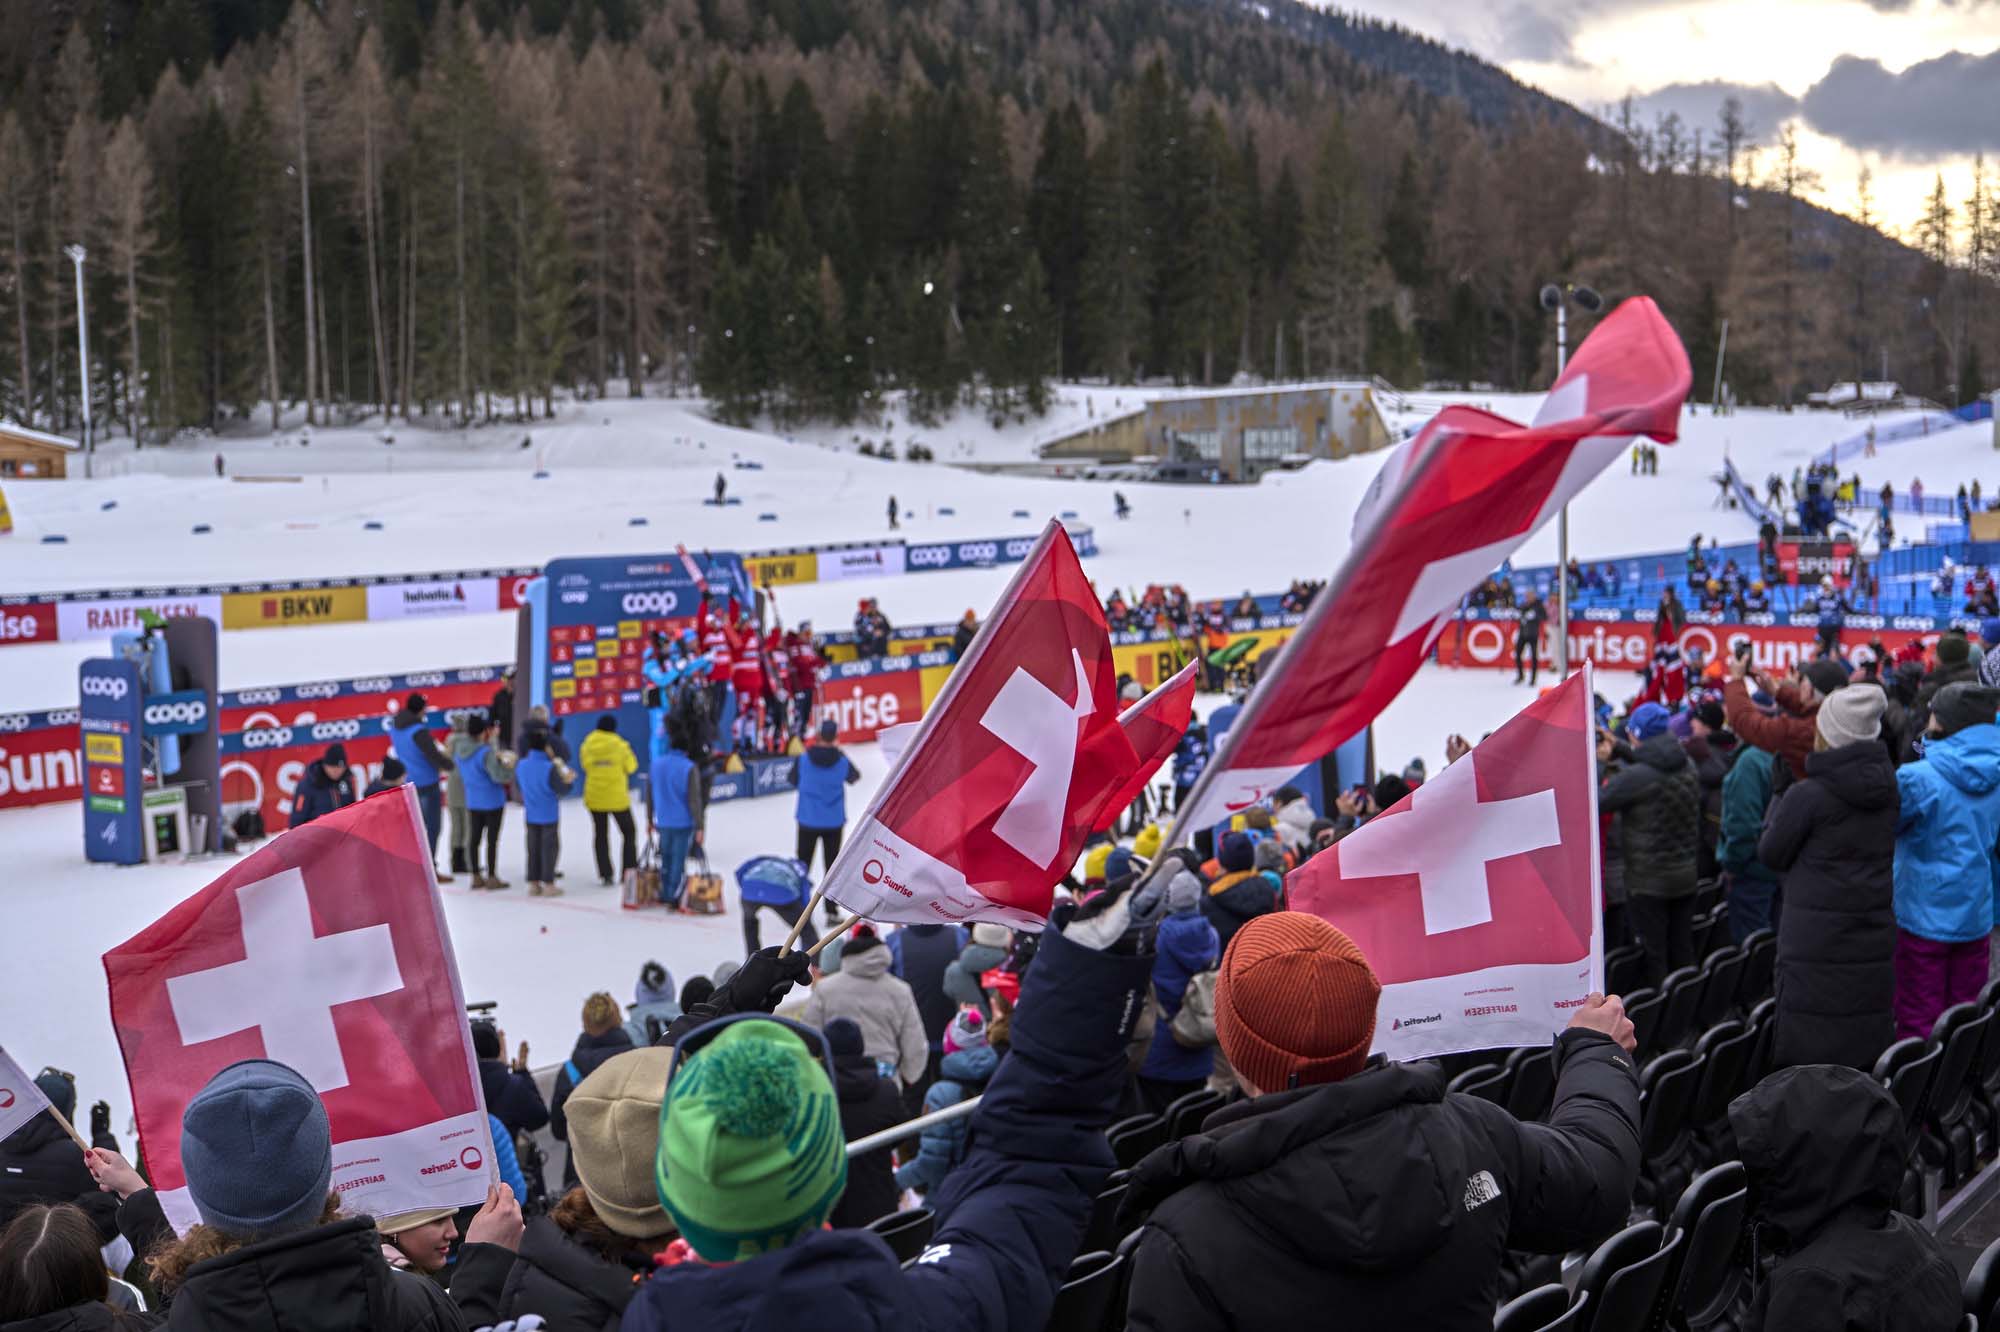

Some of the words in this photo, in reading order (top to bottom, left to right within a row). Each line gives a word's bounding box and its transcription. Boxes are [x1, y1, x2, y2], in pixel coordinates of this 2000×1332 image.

[910, 547, 950, 565] coop
[959, 543, 997, 560] coop
[1006, 541, 1035, 557] coo
[1798, 556, 1851, 574] SPORT
[280, 597, 333, 618] BKW
[622, 591, 678, 616] coop
[1584, 607, 1621, 623] coop
[1789, 614, 1820, 627] coo
[1844, 614, 1885, 631] coop
[1893, 616, 1934, 633] coop
[82, 676, 128, 700] coop
[238, 688, 281, 704] coop
[296, 681, 339, 698] coop
[352, 677, 392, 692] coop
[406, 671, 445, 686] coop
[47, 711, 80, 726] coo
[145, 701, 207, 725] coop
[243, 727, 293, 748] coop
[311, 719, 360, 739] coop
[883, 875, 913, 897] Sunrise
